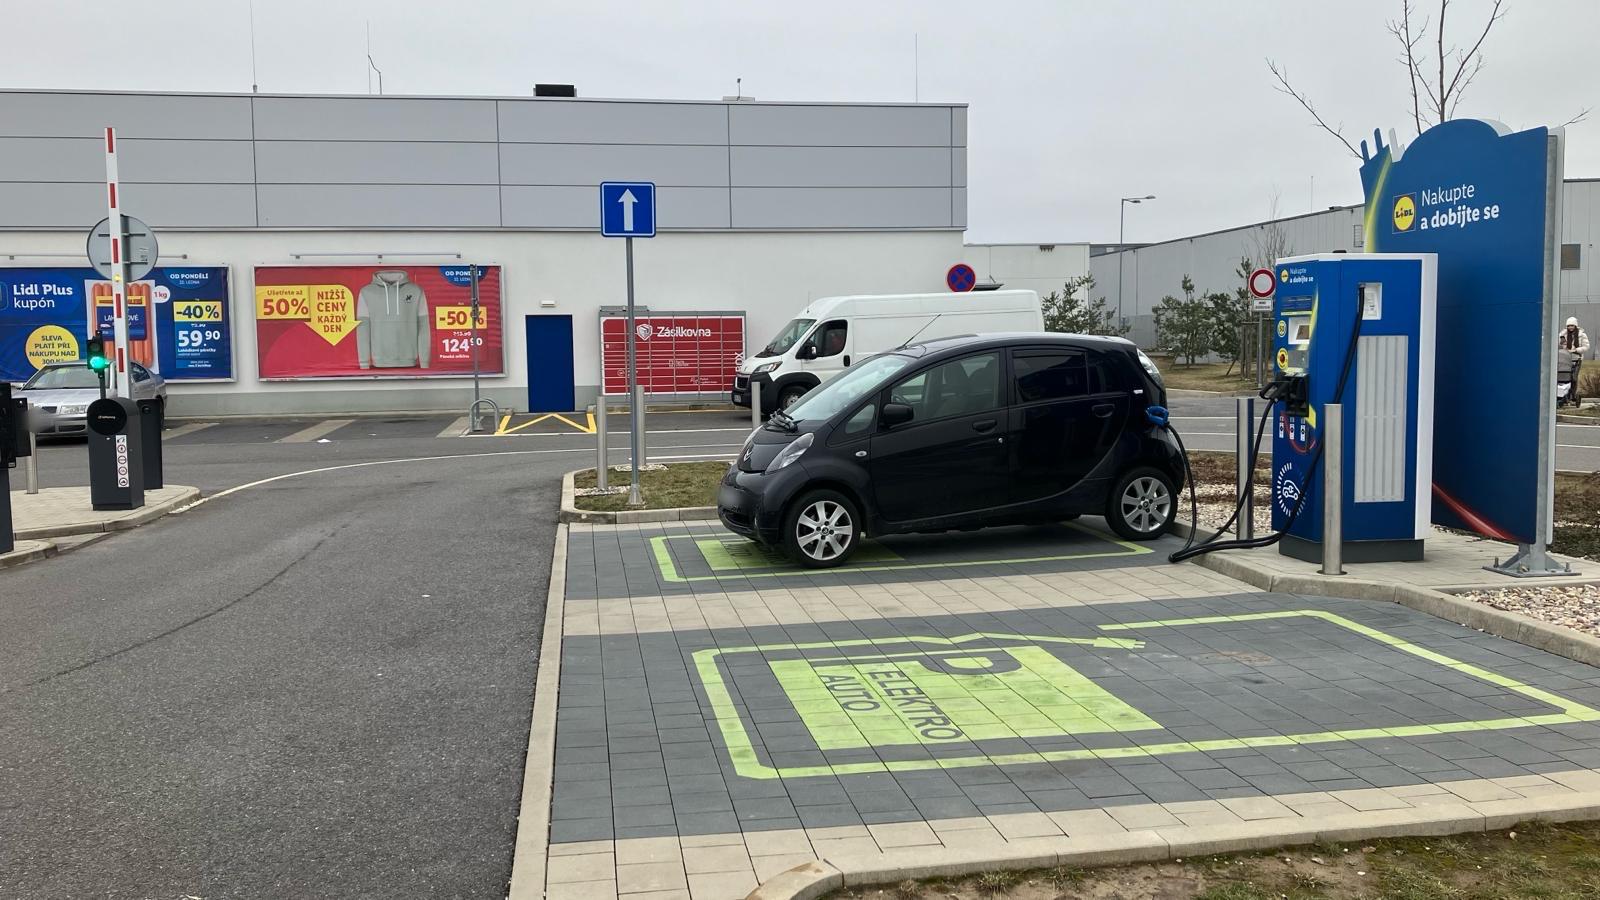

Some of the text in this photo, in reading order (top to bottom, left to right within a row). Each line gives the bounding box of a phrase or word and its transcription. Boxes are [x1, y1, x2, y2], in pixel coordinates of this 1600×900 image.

[1421, 184, 1475, 207] Nakupte
[1420, 204, 1500, 230] a dobijte se
[13, 284, 73, 295] Lidl Plus
[317, 289, 346, 300] NIŽŠÍ
[14, 297, 55, 311] kupón
[263, 298, 309, 316] 50%
[317, 302, 347, 312] CENY
[176, 305, 220, 319] -40%
[317, 313, 347, 323] KAŽDÝ
[323, 325, 342, 333] DEN
[656, 326, 712, 338] Zásilkovna
[818, 674, 881, 711] AUTO
[867, 670, 964, 739] ELEKTRO
